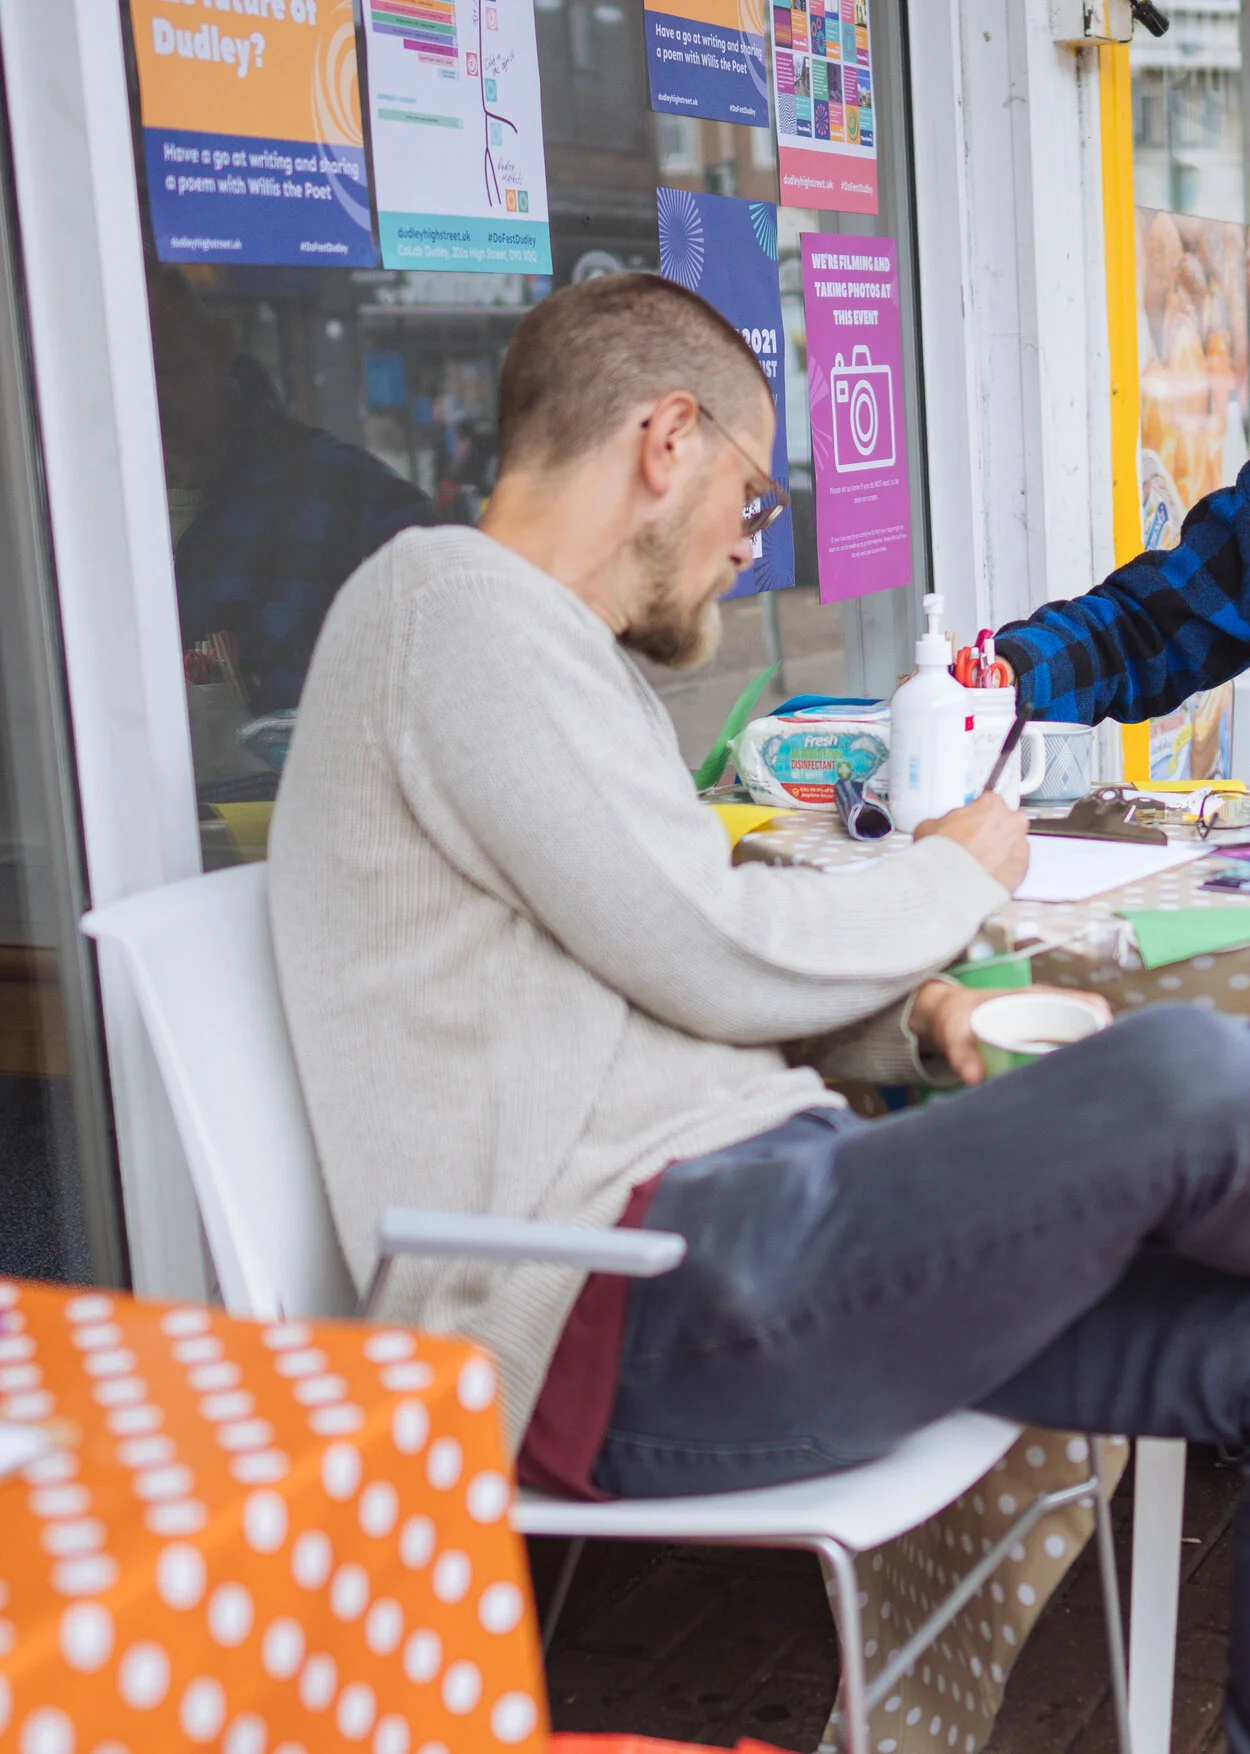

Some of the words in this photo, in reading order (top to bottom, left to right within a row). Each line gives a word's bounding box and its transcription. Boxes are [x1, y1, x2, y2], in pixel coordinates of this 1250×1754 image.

[152, 17, 266, 78] Dudley?
[655, 23, 674, 39] Have
[676, 30, 681, 40] a
[682, 31, 692, 45] go
[693, 32, 701, 44] at
[702, 34, 726, 53] writing
[727, 40, 739, 53] and
[740, 41, 763, 61] sharing
[656, 47, 661, 58] a
[663, 49, 684, 62] poem
[685, 50, 700, 65] with
[701, 53, 719, 69] Willis
[720, 57, 731, 71] the
[732, 60, 748, 74] Poet
[163, 142, 199, 164] Have
[201, 150, 211, 164] a
[214, 150, 230, 170] go
[232, 151, 248, 167] at
[249, 150, 293, 175] writing
[294, 156, 317, 172] and
[319, 157, 360, 180] sharing
[165, 175, 176, 190] a
[178, 175, 216, 196] poem
[217, 174, 246, 195] with
[248, 177, 281, 197] Willis
[283, 180, 303, 198] the
[305, 182, 332, 200] Poet
[397, 227, 471, 243] dudleyhighstreet.uk
[488, 232, 537, 248] #DoFestDudley
[811, 253, 839, 270] WE'RE
[839, 255, 873, 271] FILMING
[873, 256, 891, 272] AND
[814, 281, 847, 297] TAKING
[848, 282, 880, 298] PHOTOS
[881, 283, 891, 298] AT
[833, 309, 853, 325] THIS
[853, 309, 879, 325] EVENT
[742, 328, 777, 354] 2021
[804, 735, 838, 748] Fresh
[791, 760, 835, 770] DISINFECTANT
